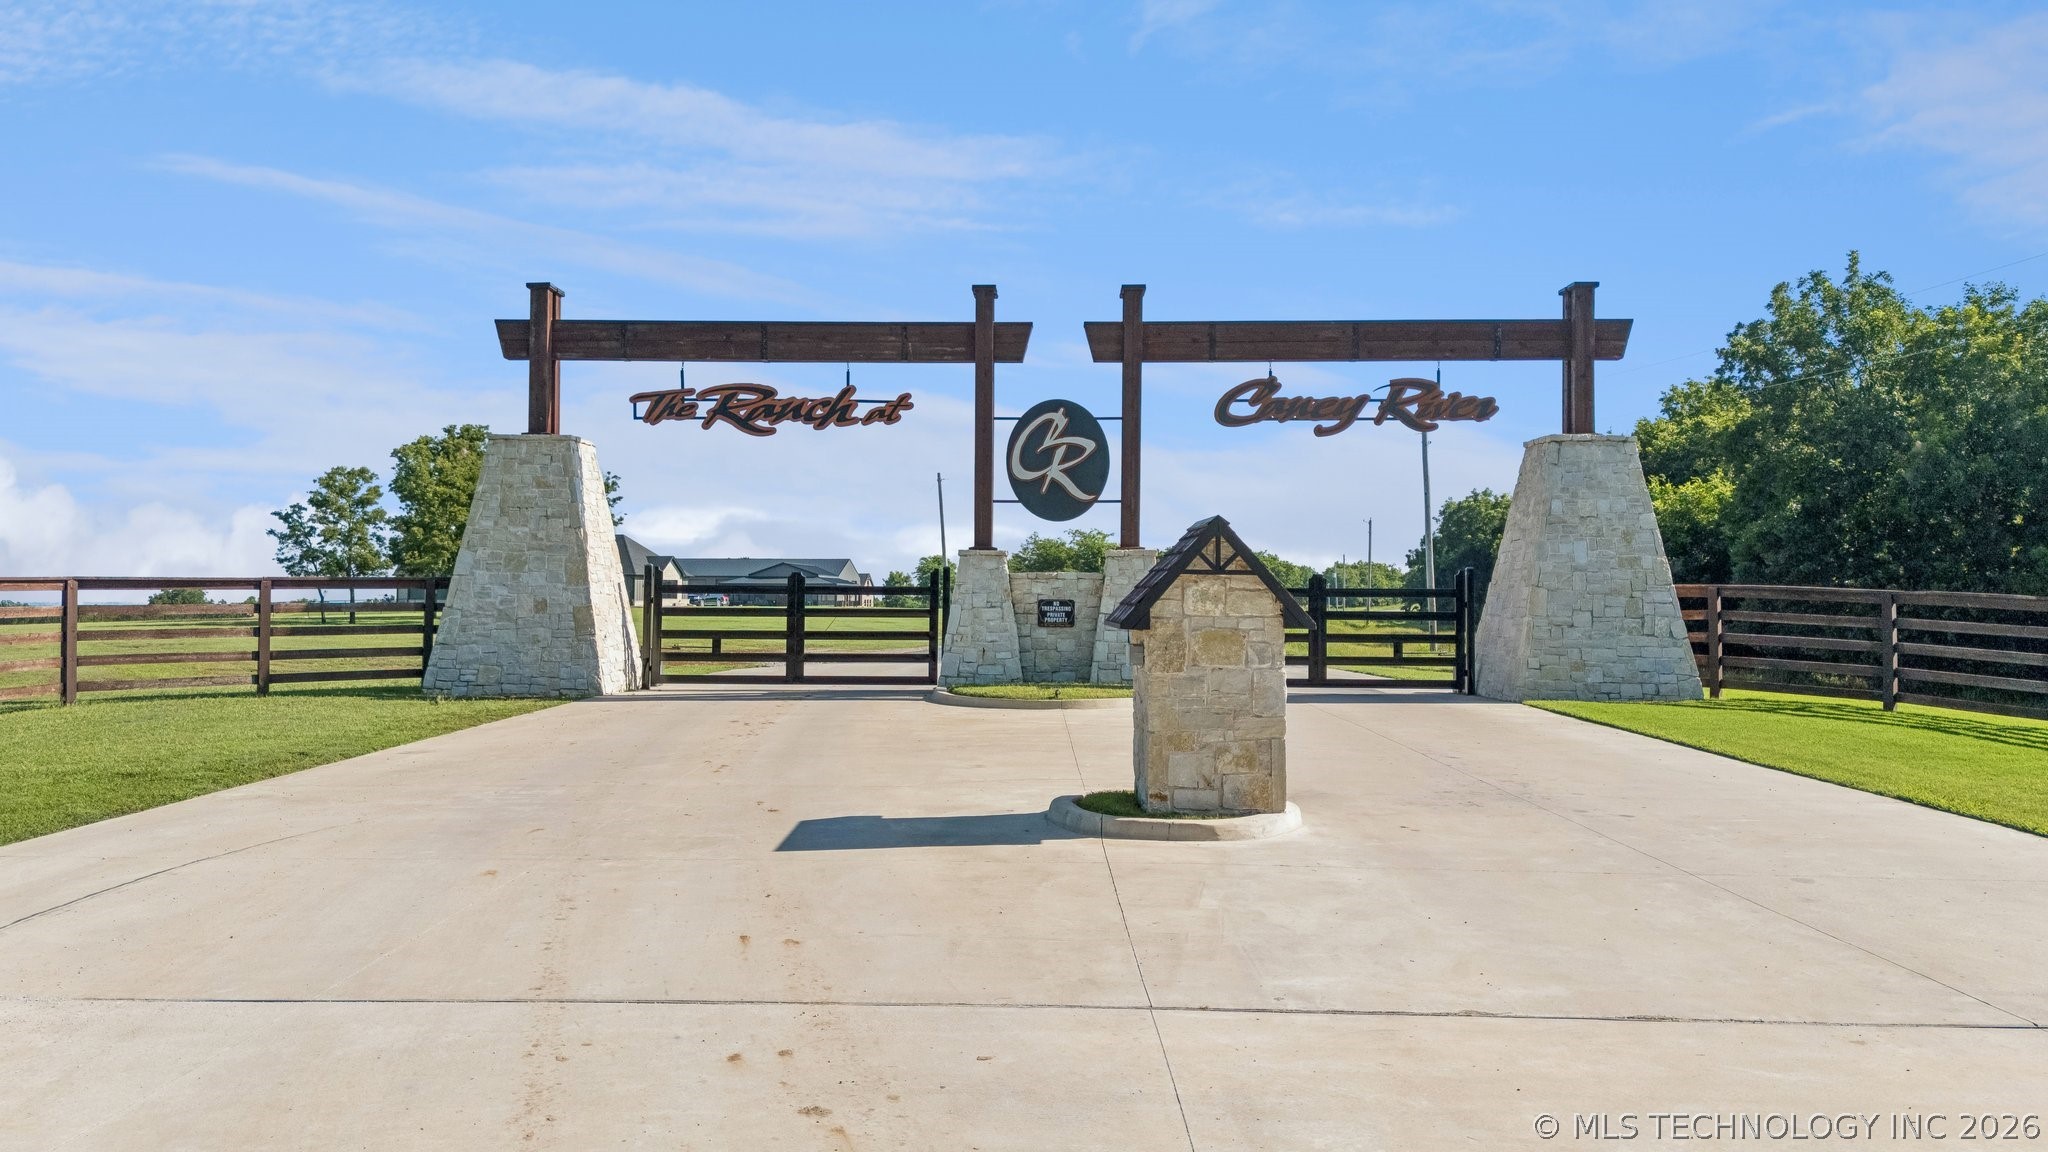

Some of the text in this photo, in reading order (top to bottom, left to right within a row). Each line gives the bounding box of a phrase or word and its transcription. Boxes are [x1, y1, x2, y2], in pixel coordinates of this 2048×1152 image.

[629, 383, 914, 436] The Ranch at
[1214, 376, 1499, 437] Caney River
